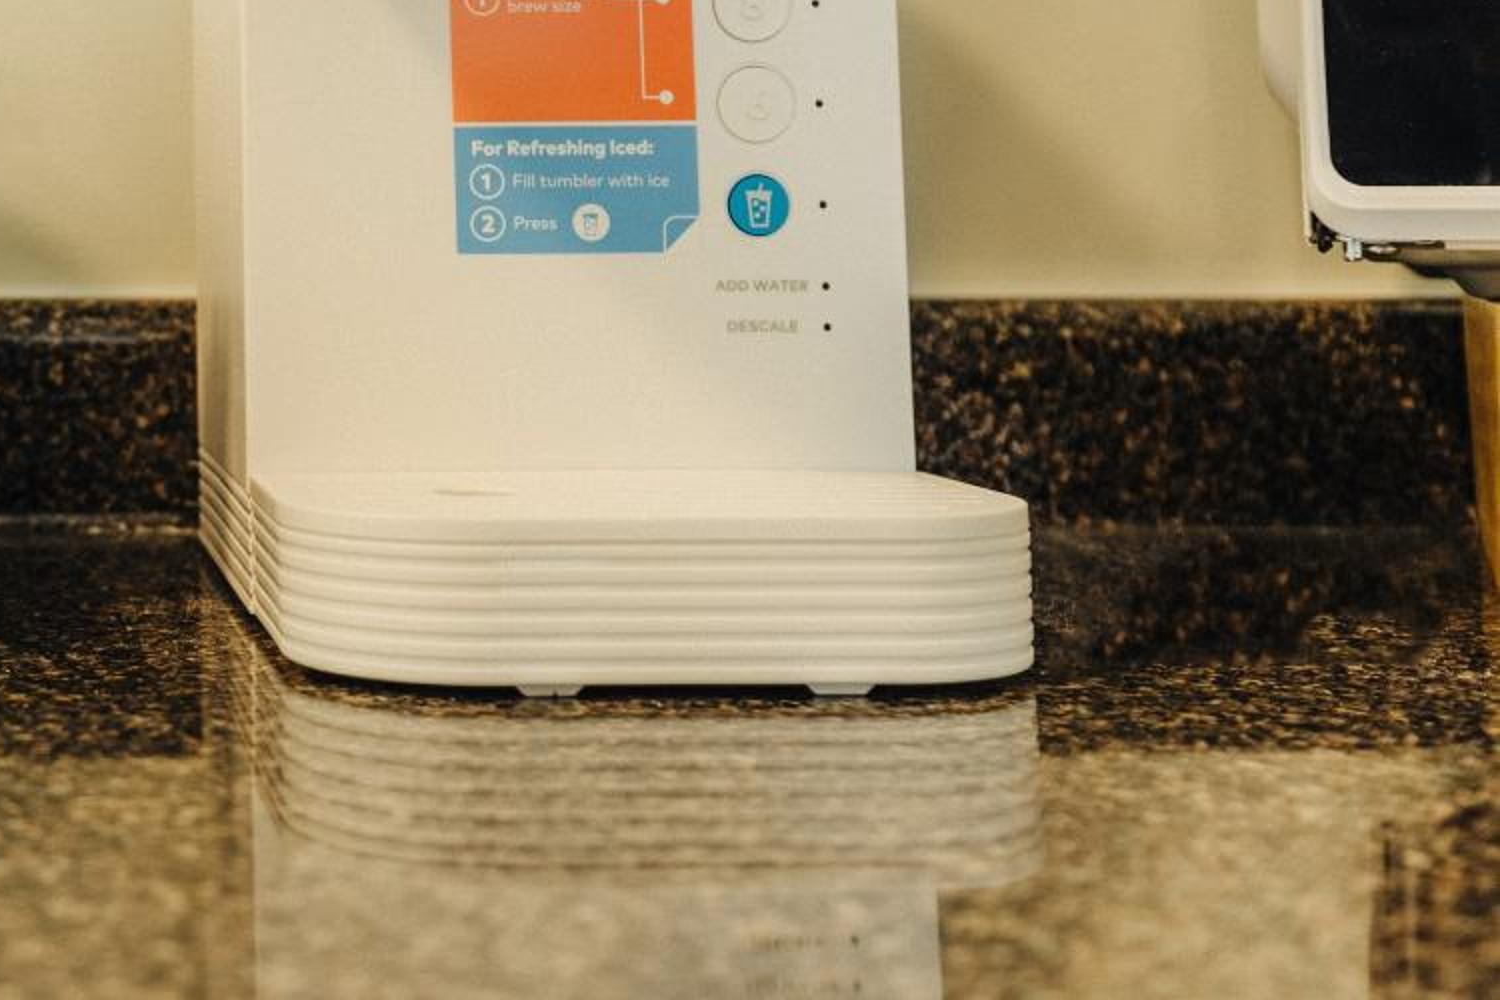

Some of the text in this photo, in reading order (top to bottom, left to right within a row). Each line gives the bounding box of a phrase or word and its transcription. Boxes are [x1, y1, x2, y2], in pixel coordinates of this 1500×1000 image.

[507, 0, 581, 14] brew size
[471, 139, 654, 160] For Refreshing Iced:
[481, 173, 670, 190] 1 Fill tumbler with ice
[481, 214, 558, 234] 2 Press
[715, 280, 807, 292] ADD WATER
[726, 320, 798, 333] DESCALE
